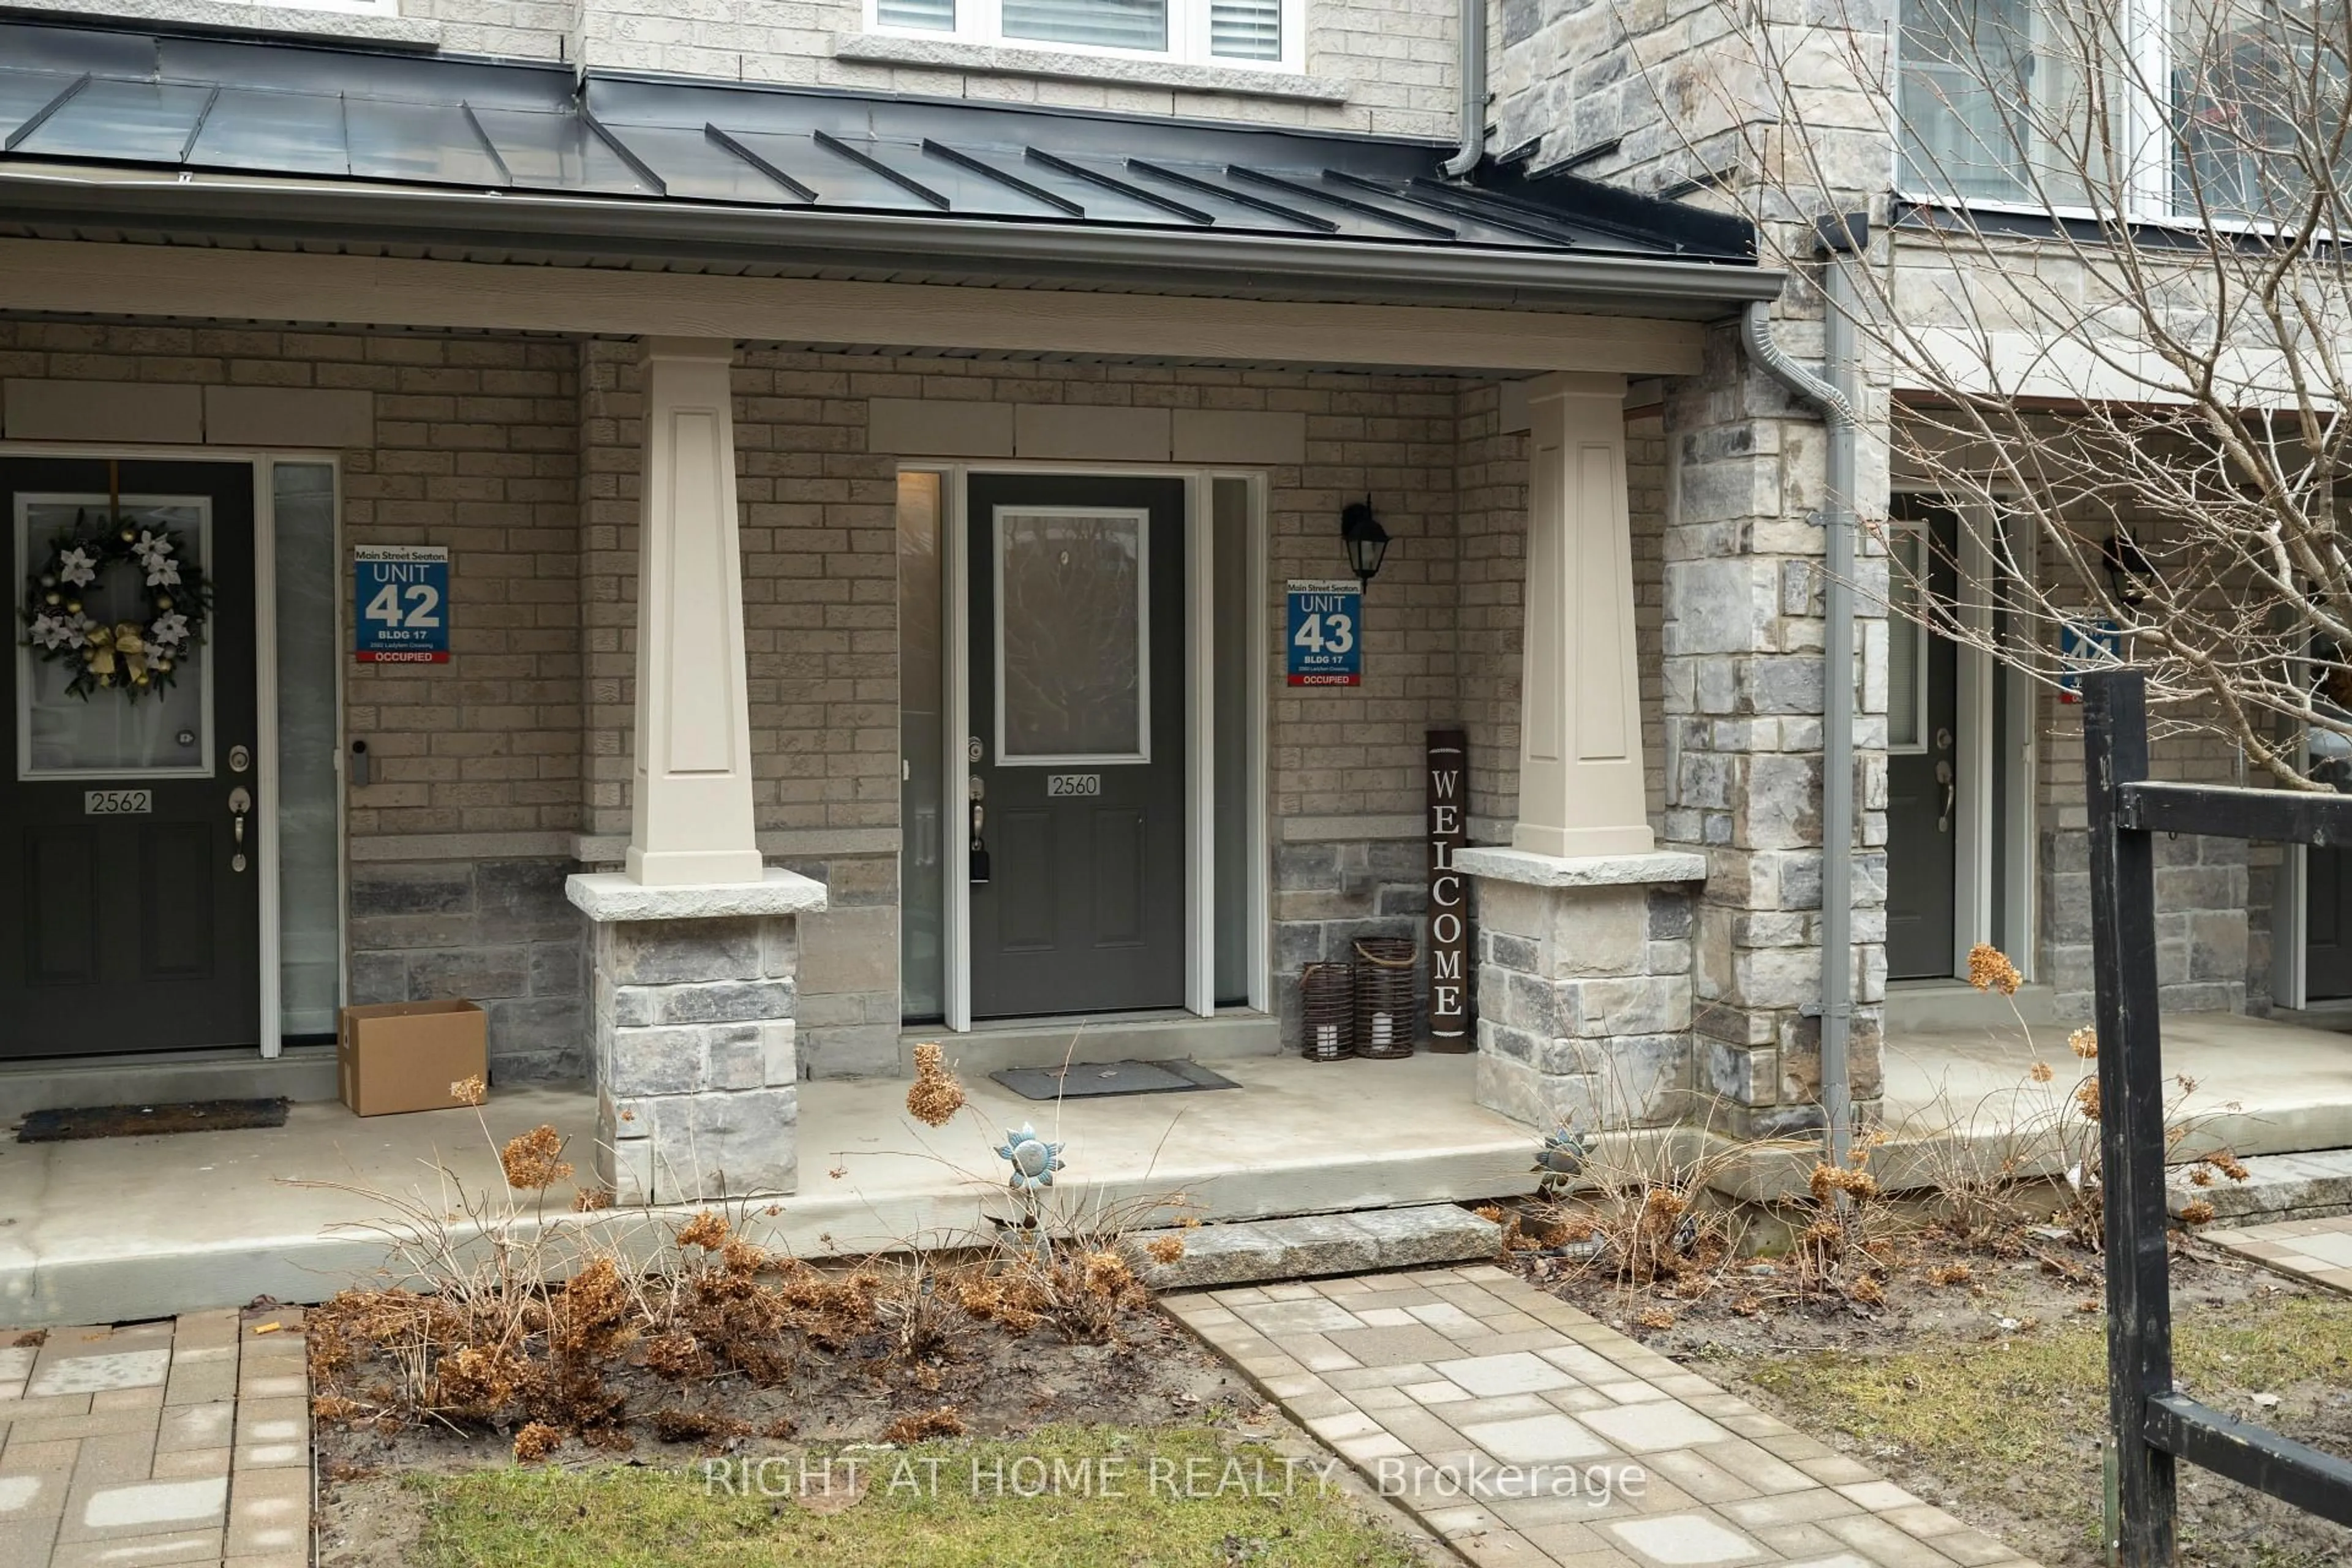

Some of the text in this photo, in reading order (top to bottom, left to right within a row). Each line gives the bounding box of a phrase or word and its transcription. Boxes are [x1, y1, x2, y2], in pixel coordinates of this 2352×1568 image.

[356, 551, 380, 560] Main
[382, 551, 409, 560] Street
[374, 564, 430, 582] UNIT
[365, 584, 439, 627] 42
[1301, 595, 1346, 612] UNIT
[1295, 614, 1353, 653] 43
[375, 652, 432, 662] OCCUPIED
[1054, 777, 1096, 794] 2560
[91, 792, 146, 812] 2562
[1432, 771, 1461, 1016] WELCOME
